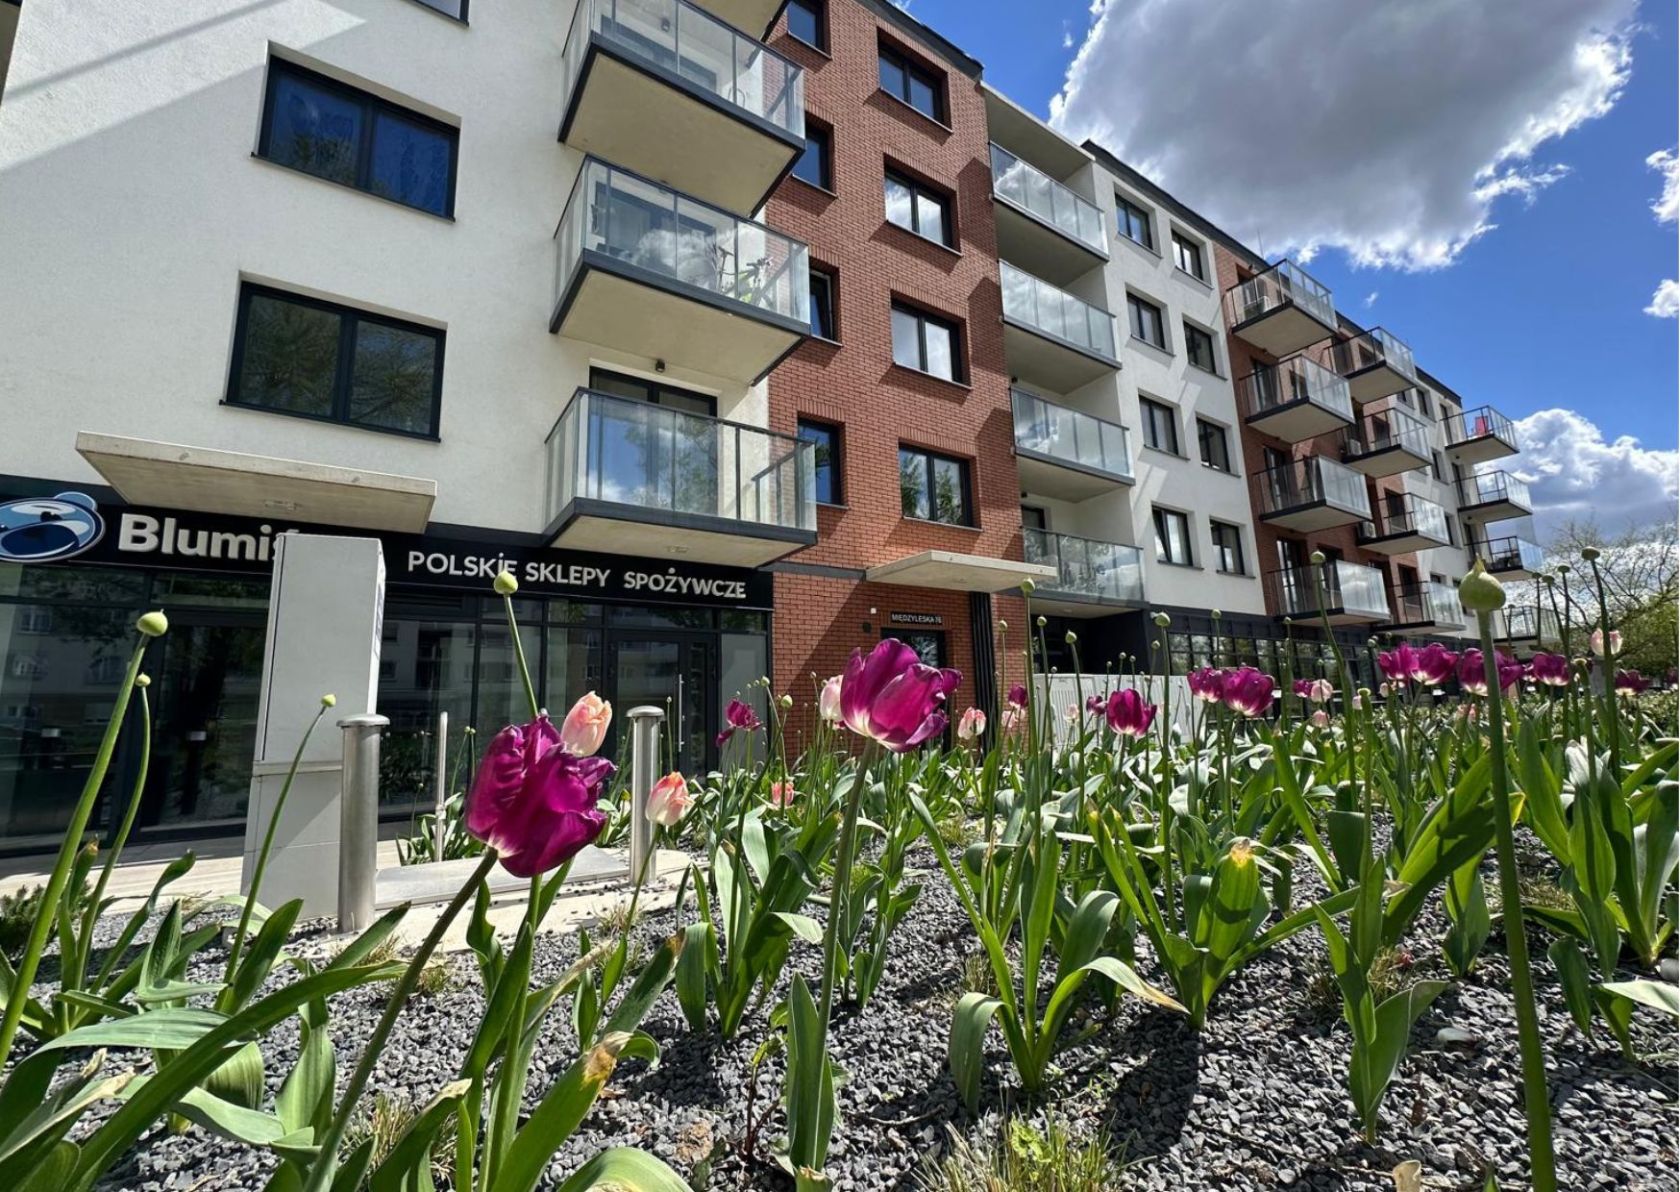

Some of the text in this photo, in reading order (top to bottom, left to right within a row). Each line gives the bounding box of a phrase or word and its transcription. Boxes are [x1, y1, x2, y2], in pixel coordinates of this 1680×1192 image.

[118, 512, 299, 562] Blumi
[525, 561, 611, 588] SKLEPY
[623, 567, 747, 599] SPOŻYWCZE
